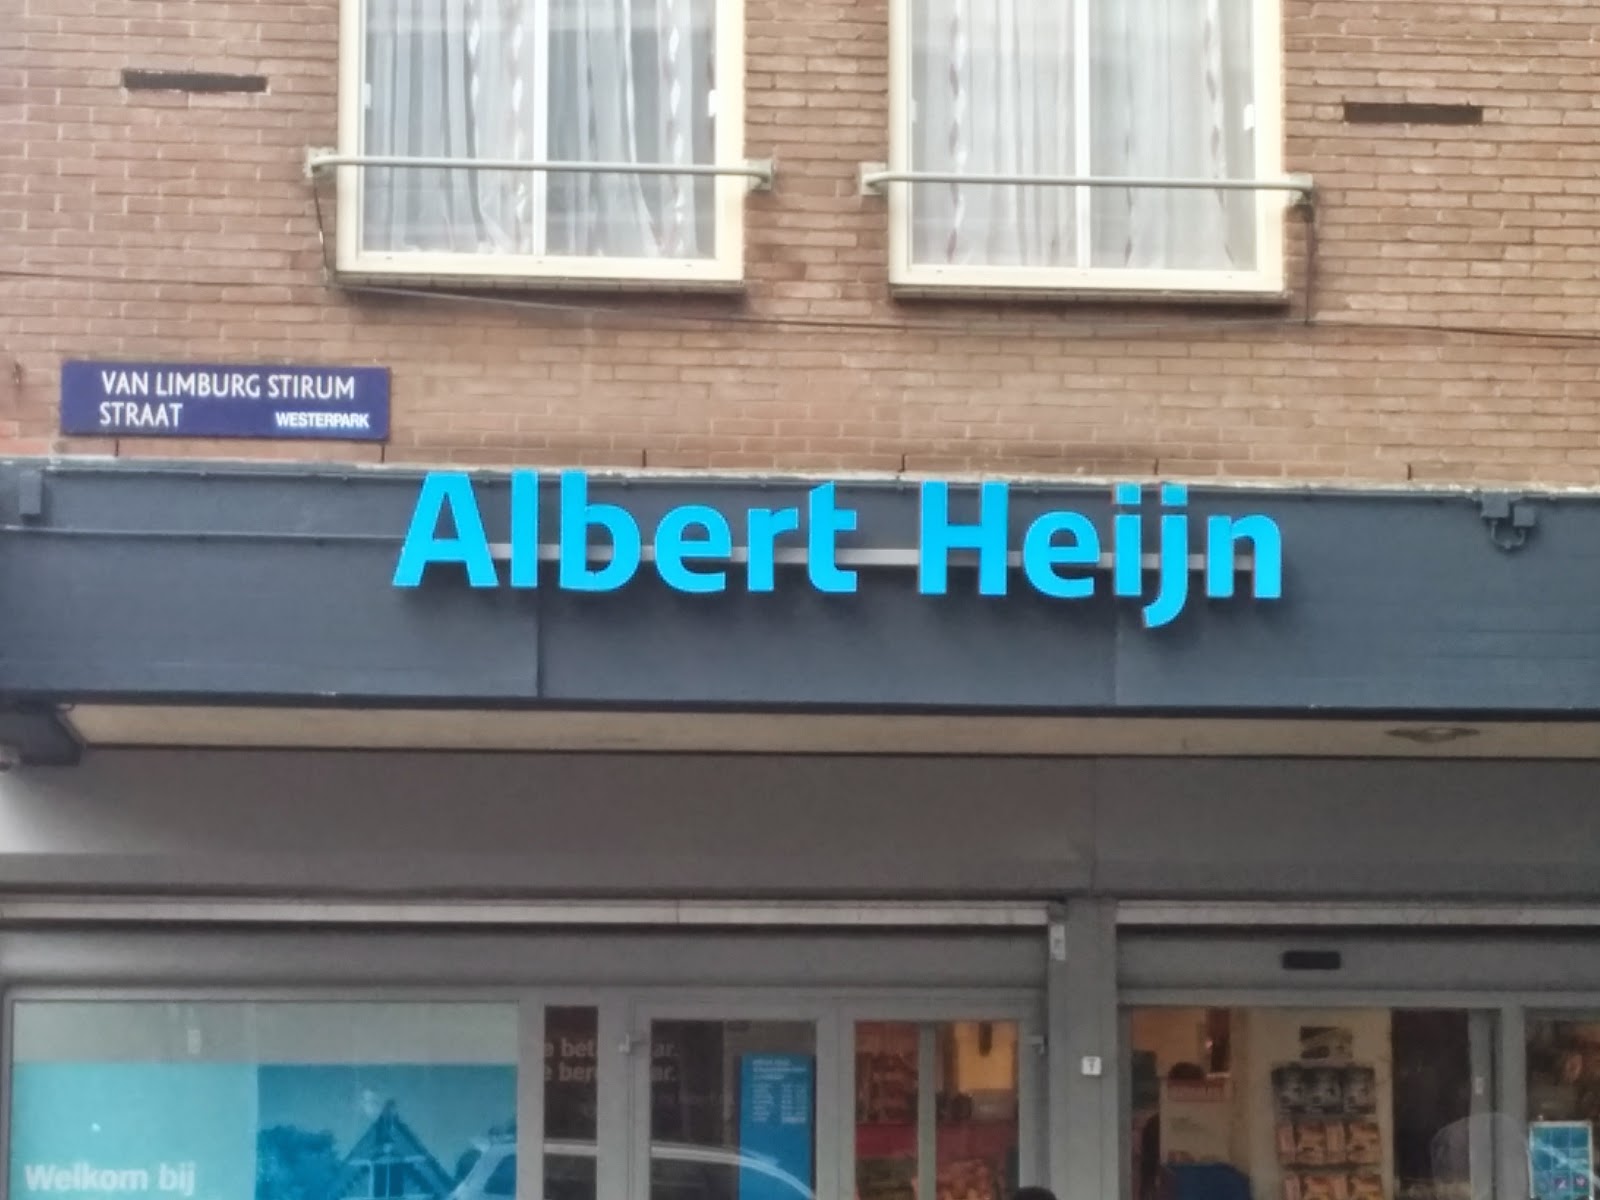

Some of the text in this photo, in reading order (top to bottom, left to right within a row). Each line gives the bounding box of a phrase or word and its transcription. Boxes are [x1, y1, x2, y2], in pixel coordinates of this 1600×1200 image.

[101, 371, 356, 399] VAN LIMBURG STIRUM
[99, 402, 183, 427] STRAAT
[275, 412, 370, 428] WESTERPARK
[393, 470, 1282, 628] Albert Heijn
[24, 1160, 196, 1197] Welkom bij
